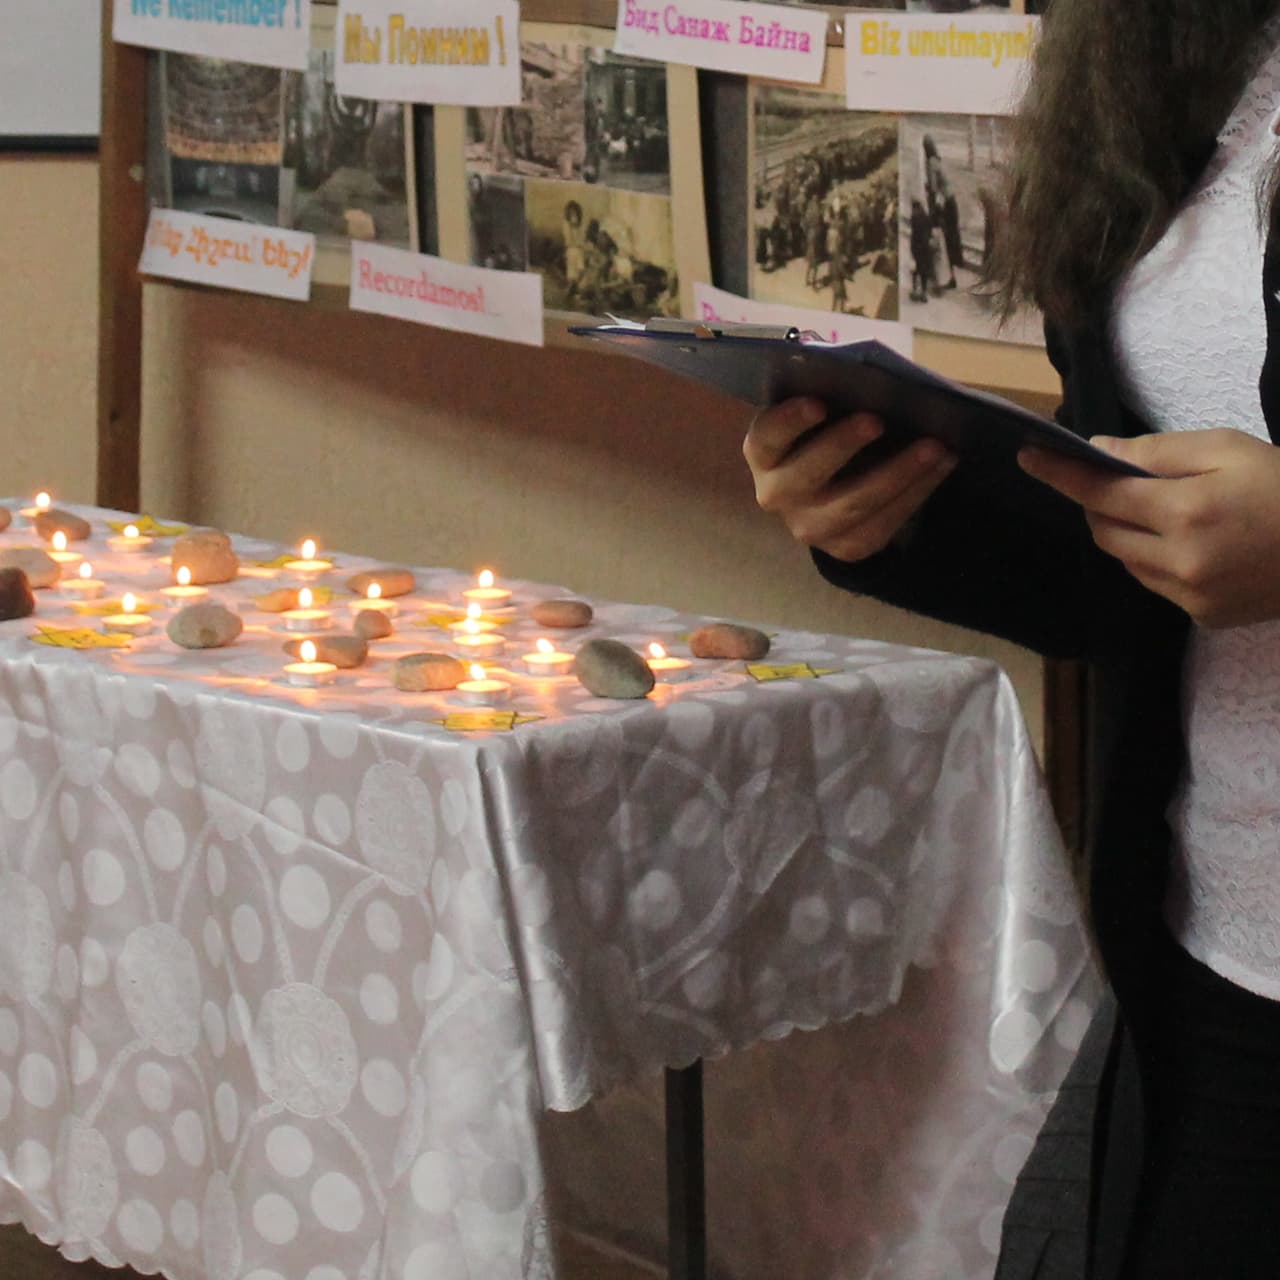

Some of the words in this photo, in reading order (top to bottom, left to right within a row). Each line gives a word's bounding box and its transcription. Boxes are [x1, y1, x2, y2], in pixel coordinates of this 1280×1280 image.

[344, 13, 382, 64] Мы
[388, 13, 490, 65] Помним
[663, 4, 730, 43] Санаж
[738, 15, 811, 54] Байна
[860, 21, 902, 57] Biz
[358, 258, 486, 312] Recordamos!
